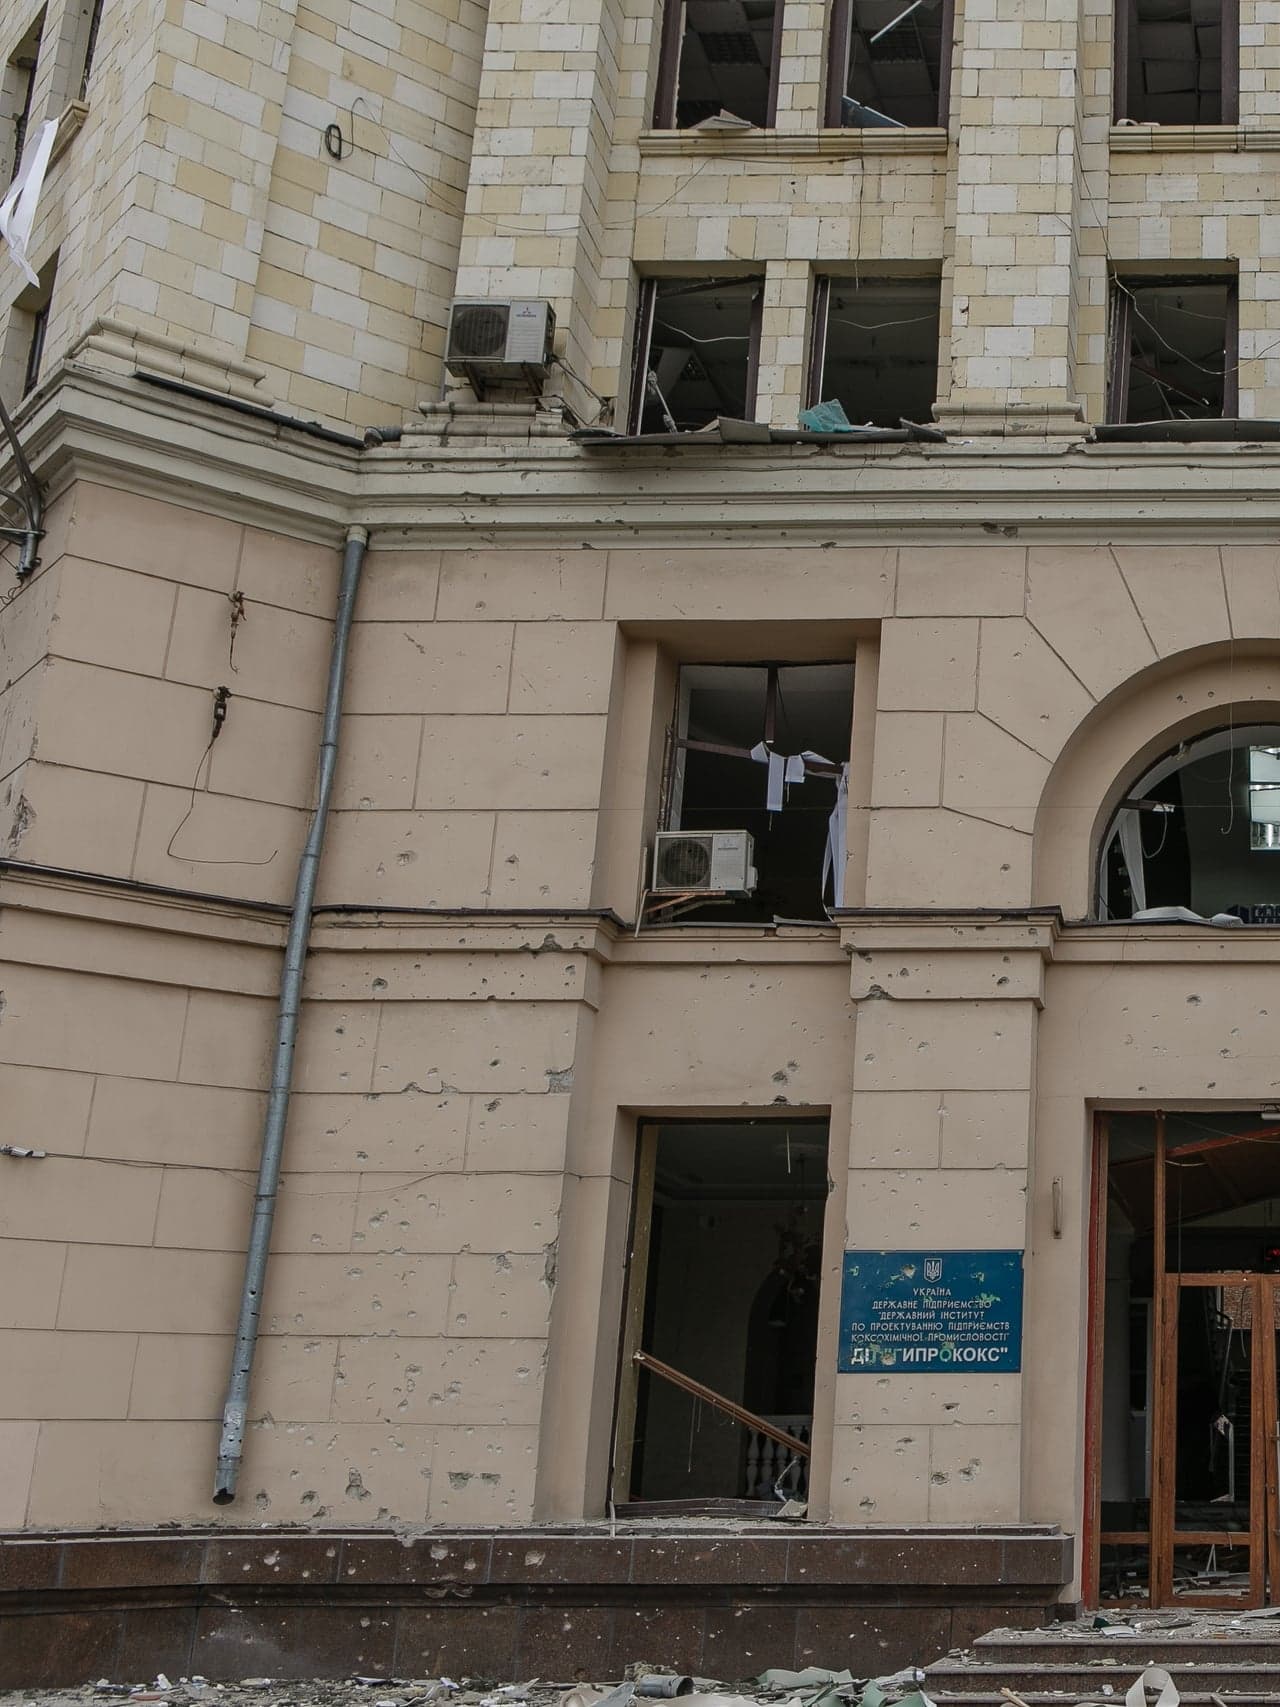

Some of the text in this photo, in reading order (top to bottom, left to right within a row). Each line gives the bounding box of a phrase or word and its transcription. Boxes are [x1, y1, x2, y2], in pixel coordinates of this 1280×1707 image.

[913, 1287, 952, 1296] УКРАЇНА
[872, 1300, 992, 1310] ДЕРЖАВНЕ ПІДПРИЄМСТВО
[941, 1311, 985, 1321] ІНСТИТУТ
[852, 1322, 1010, 1331] ПО ПРОЕКТУВАННЮ ПІДПРИЄМСТВ
[851, 1332, 923, 1342] КОКСОХІМІЧНОЇ
